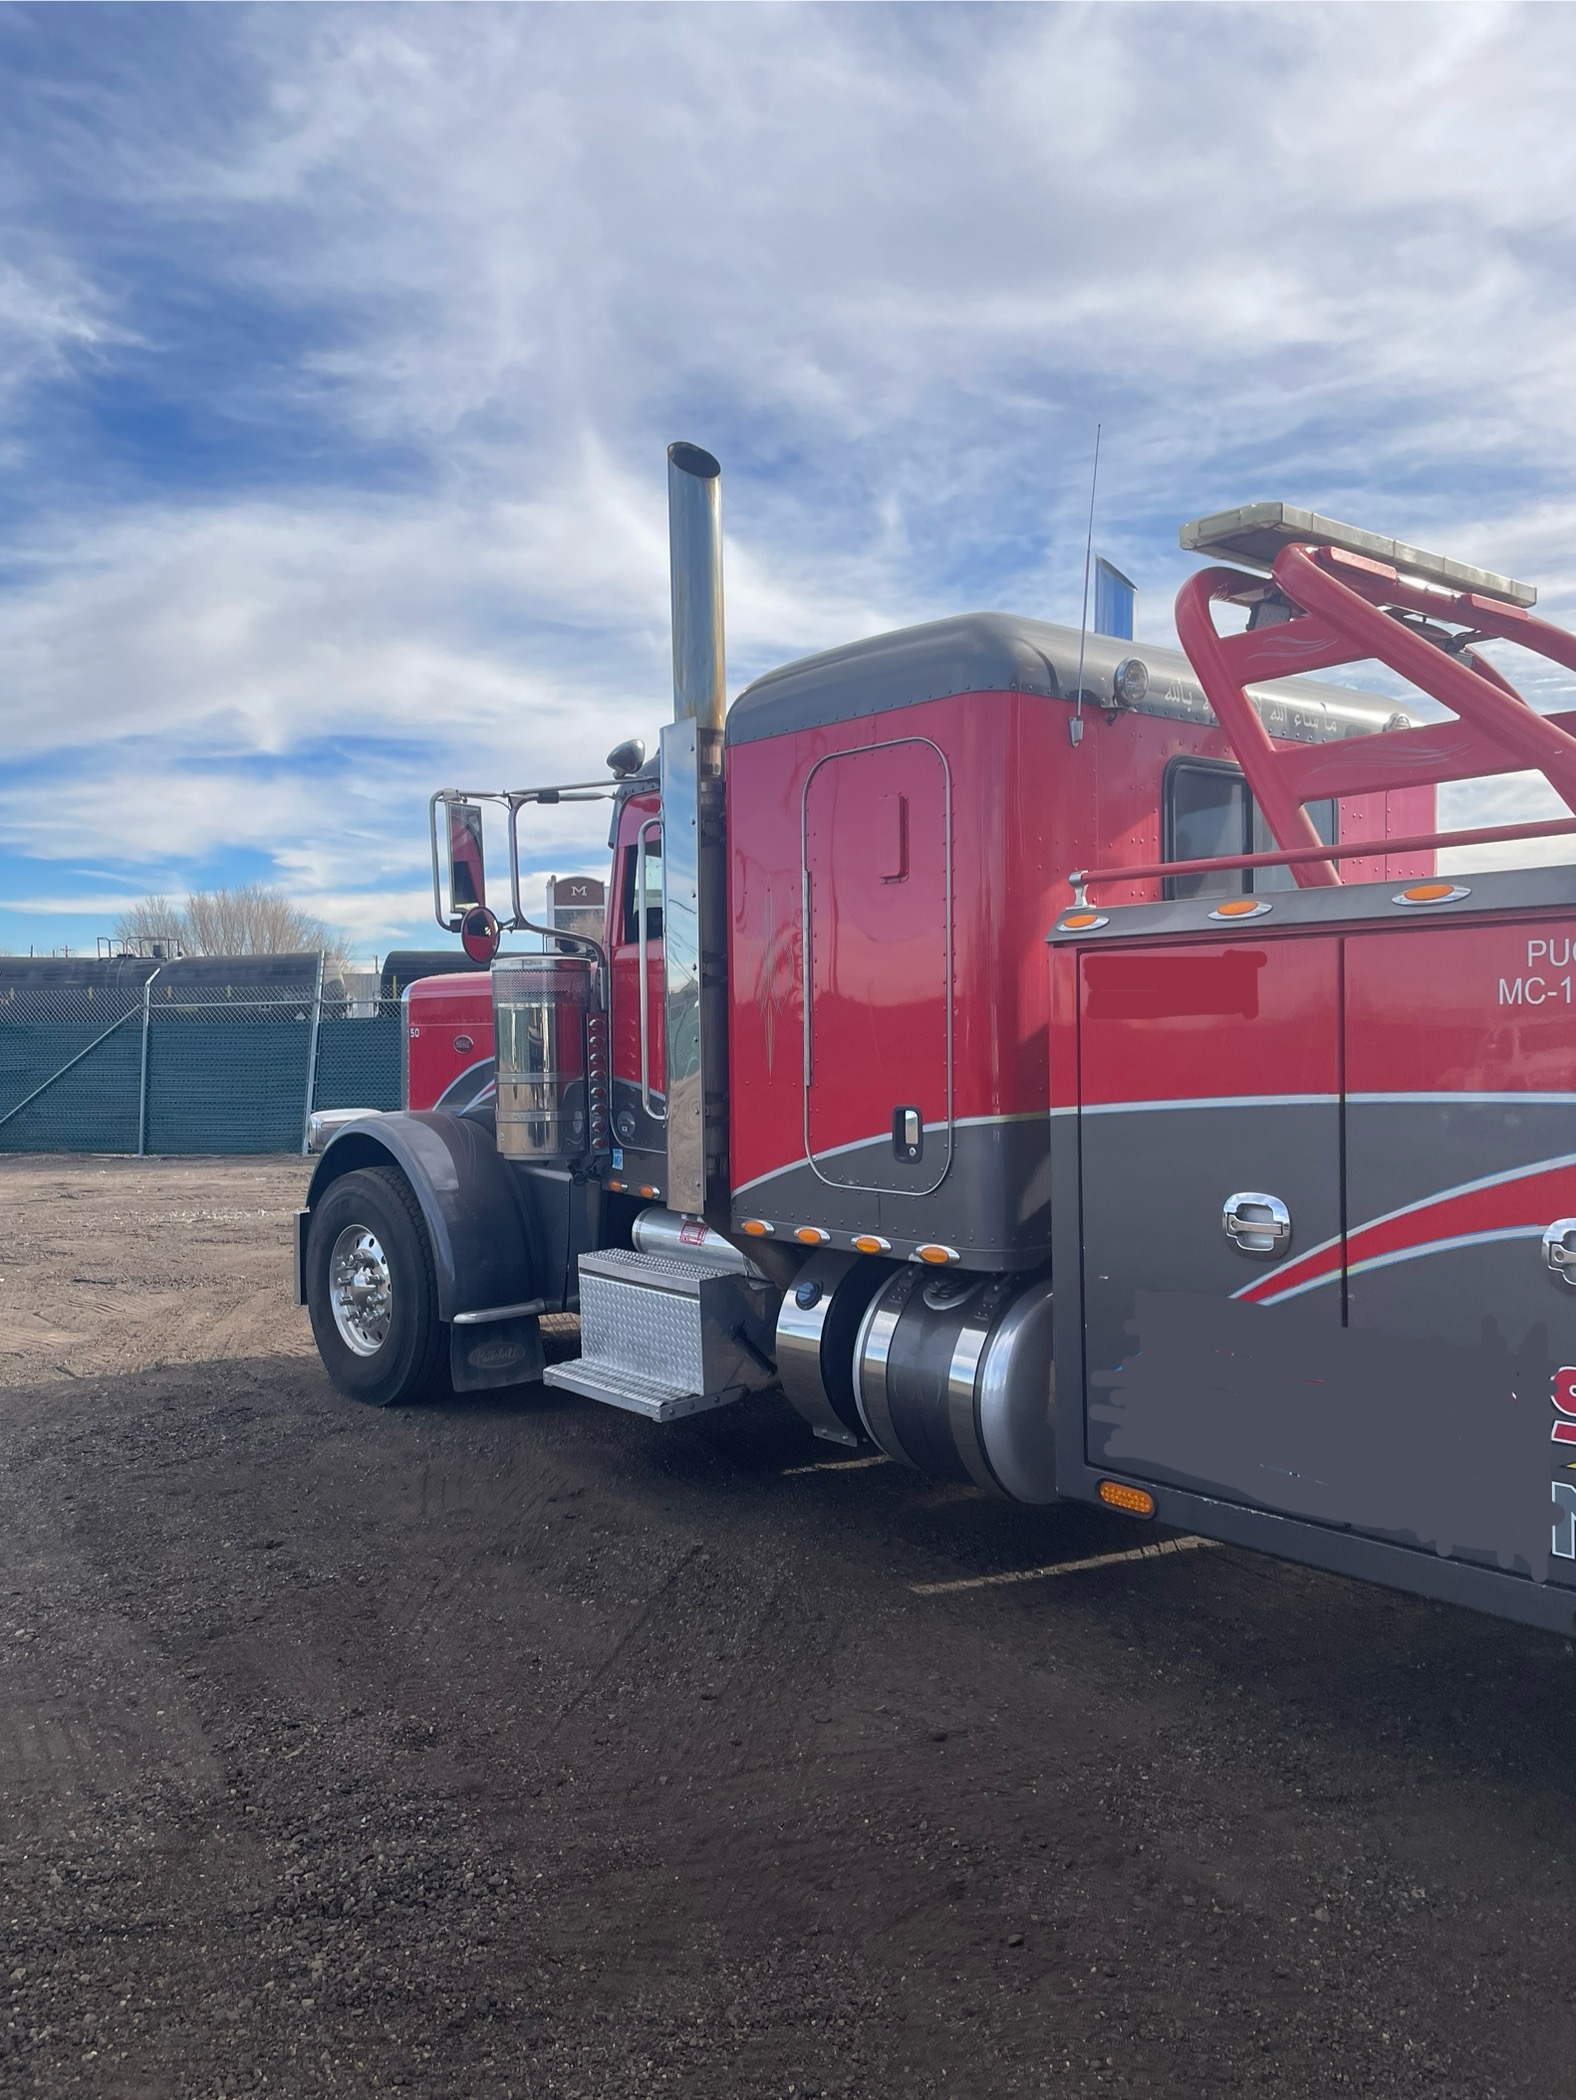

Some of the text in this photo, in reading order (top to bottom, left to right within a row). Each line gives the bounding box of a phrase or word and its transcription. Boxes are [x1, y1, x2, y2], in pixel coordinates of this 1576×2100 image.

[570, 885, 588, 897] M
[1527, 938, 1576, 967] PU
[409, 1027, 420, 1038] 50
